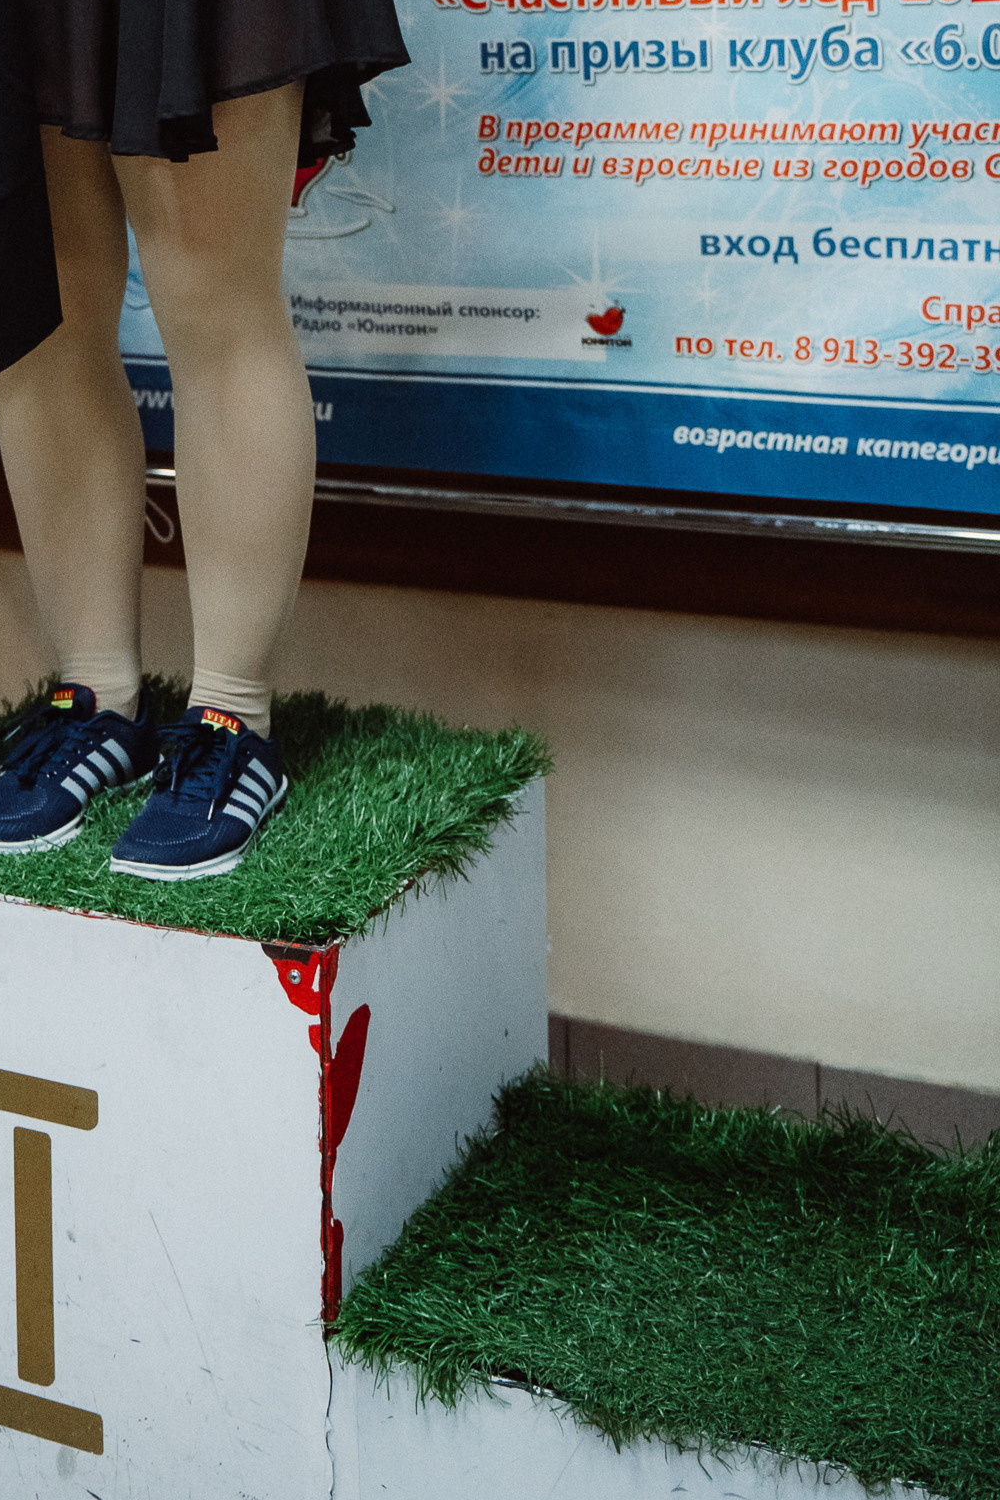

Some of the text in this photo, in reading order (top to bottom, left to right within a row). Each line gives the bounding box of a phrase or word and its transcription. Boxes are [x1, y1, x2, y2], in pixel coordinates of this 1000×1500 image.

[481, 41, 532, 71] на
[551, 40, 708, 81] призы
[730, 26, 881, 81] клуба
[479, 115, 496, 140] В
[506, 118, 680, 146] программе
[691, 121, 898, 149] принимают
[479, 151, 561, 176] дети
[573, 158, 593, 176] и
[603, 158, 759, 184] взрослые
[774, 159, 811, 178] из
[823, 152, 970, 186] городов
[701, 227, 1000, 264] вход бесплатн
[292, 295, 541, 321] Информационный спонсор:
[293, 315, 438, 336] Радио «Юнитон»
[675, 336, 713, 355] по
[724, 339, 782, 359] тел.
[795, 336, 811, 361] 8
[673, 425, 848, 454] возрастная
